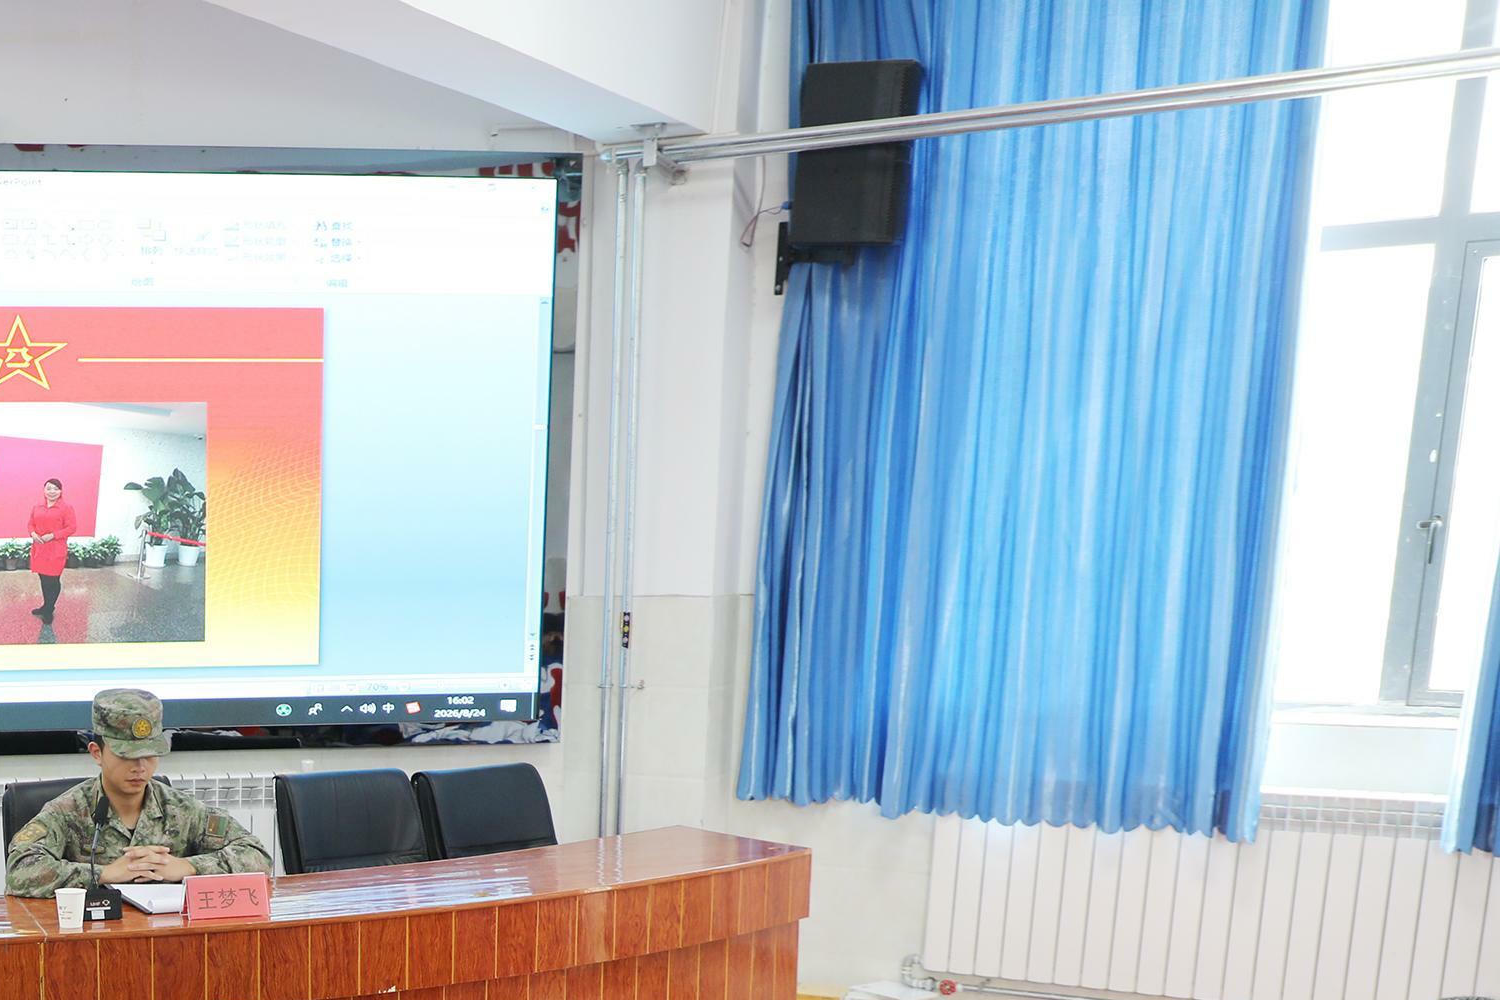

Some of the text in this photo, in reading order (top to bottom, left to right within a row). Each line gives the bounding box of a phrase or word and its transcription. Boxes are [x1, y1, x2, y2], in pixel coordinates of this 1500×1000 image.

[446, 696, 475, 705] 16:02
[434, 708, 486, 719] 2026/8/24
[197, 887, 260, 911] 王梦飞
